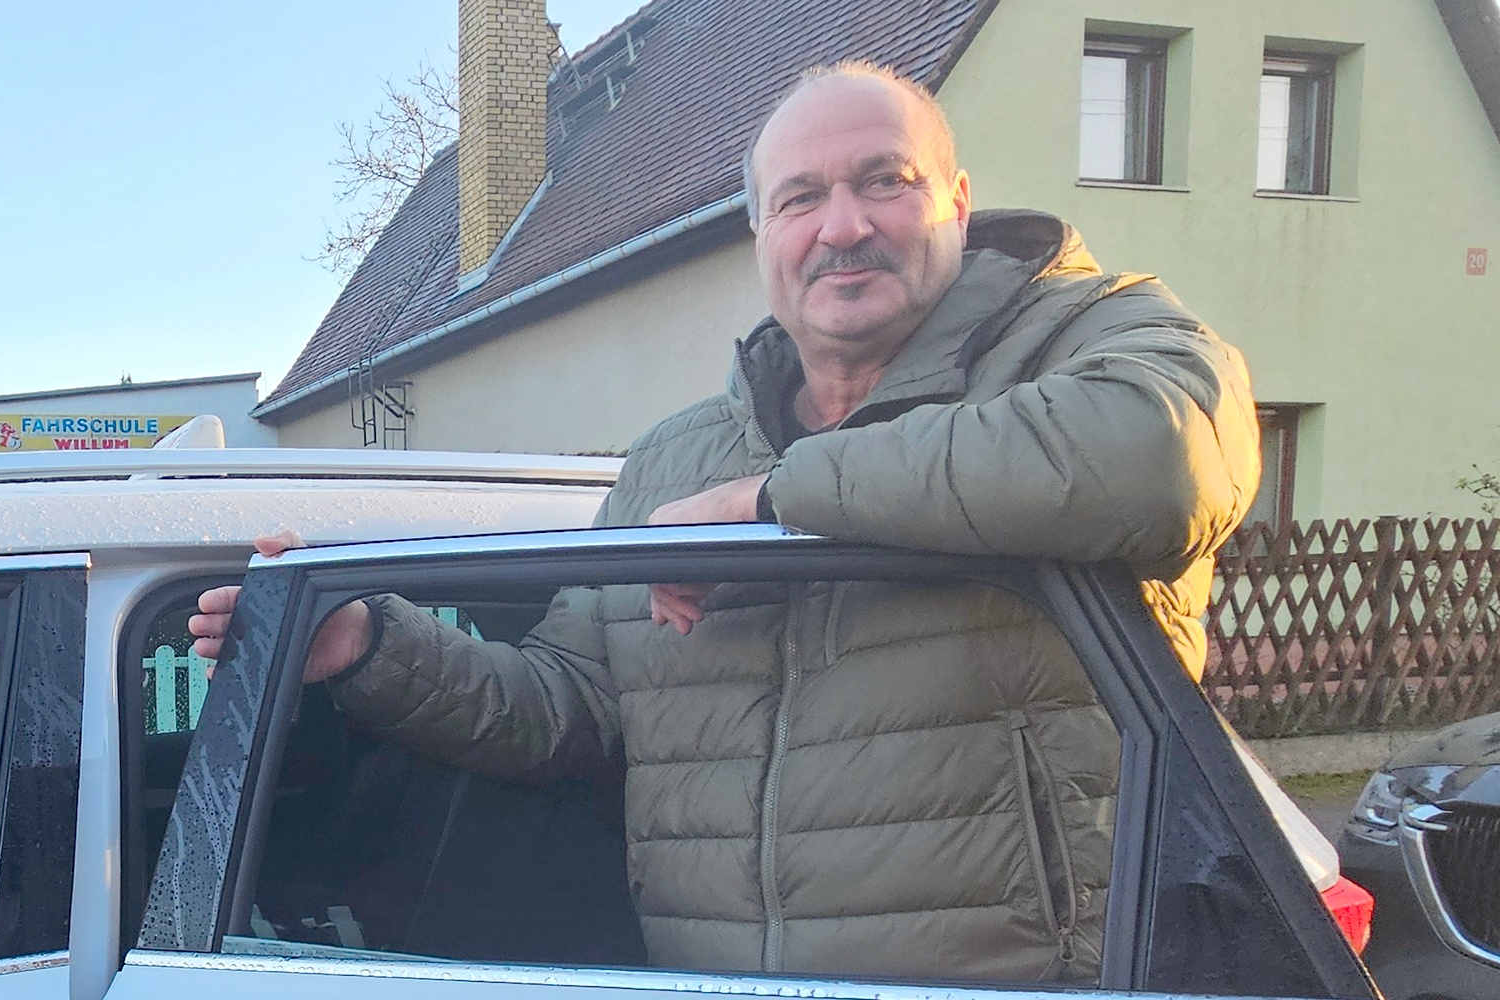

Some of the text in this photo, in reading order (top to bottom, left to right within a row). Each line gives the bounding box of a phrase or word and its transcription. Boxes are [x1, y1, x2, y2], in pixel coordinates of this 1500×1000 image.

[1469, 253, 1485, 269] 20
[21, 417, 158, 434] FAHRSCHULE
[54, 438, 129, 450] WILLUM
